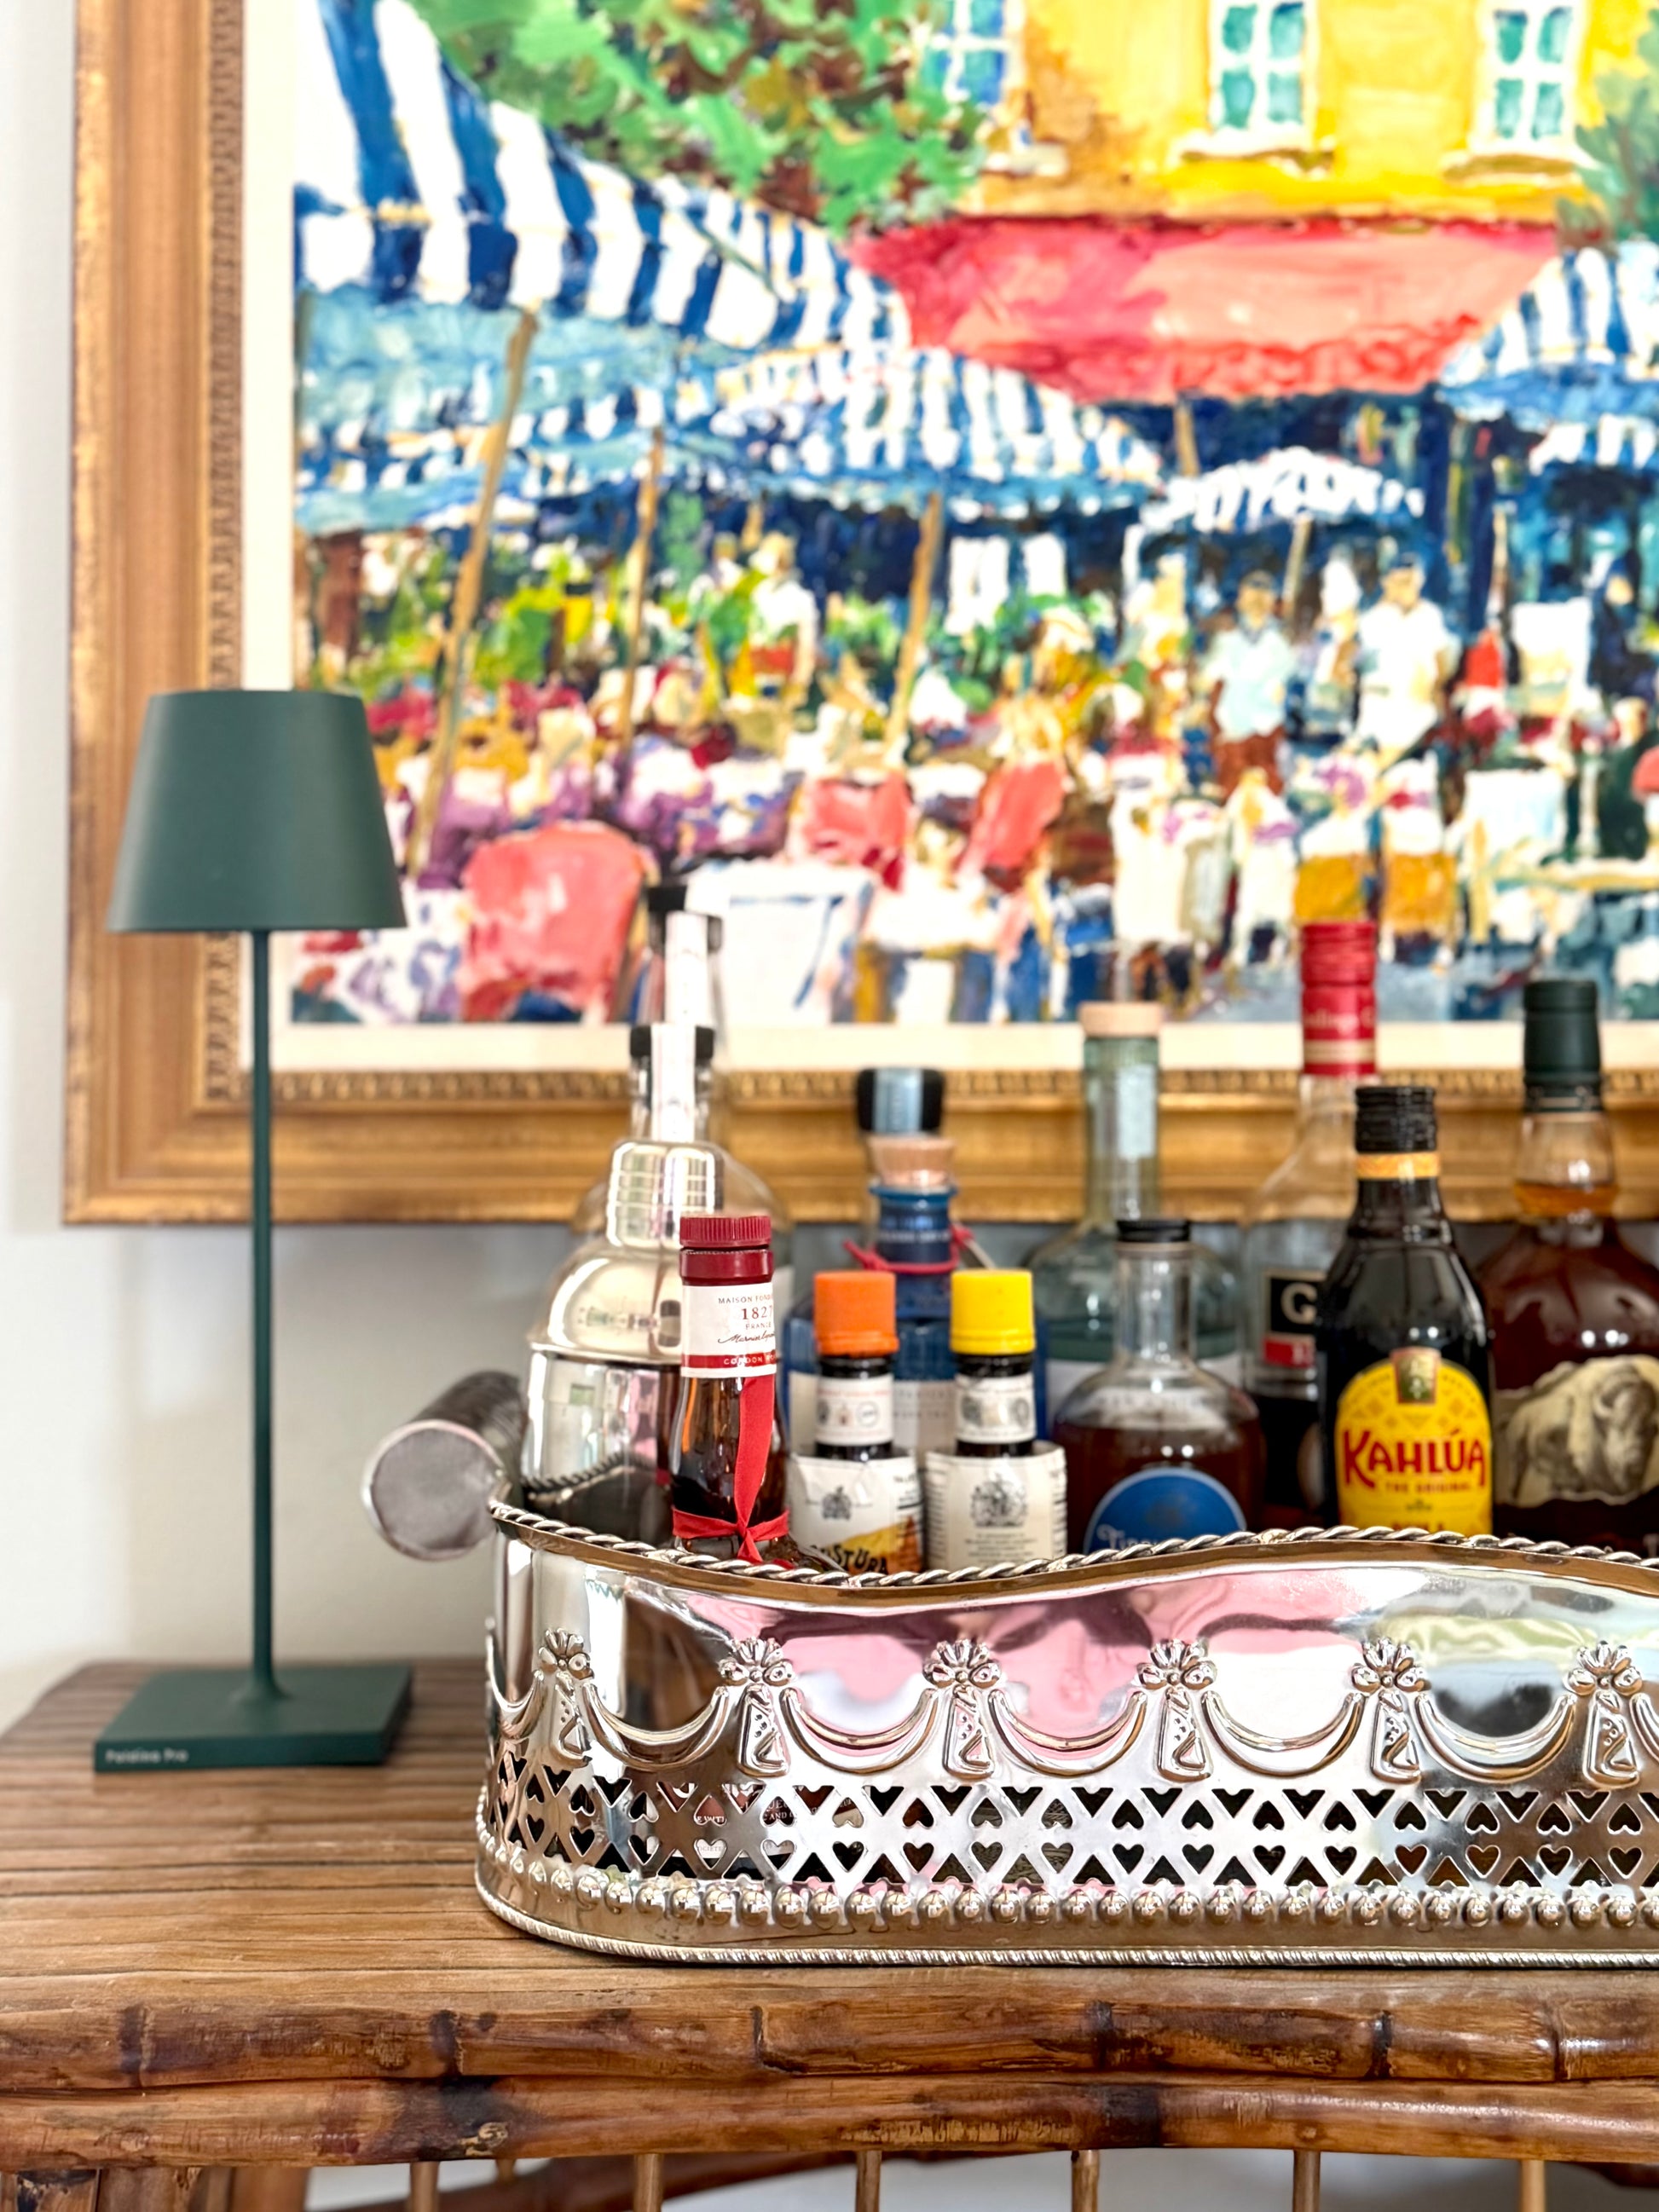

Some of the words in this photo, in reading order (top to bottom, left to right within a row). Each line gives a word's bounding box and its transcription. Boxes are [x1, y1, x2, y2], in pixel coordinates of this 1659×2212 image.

[742, 1305, 772, 1320] 1827
[1344, 1428, 1485, 1489] KAHLÚA
[821, 1544, 888, 1575] STURA
